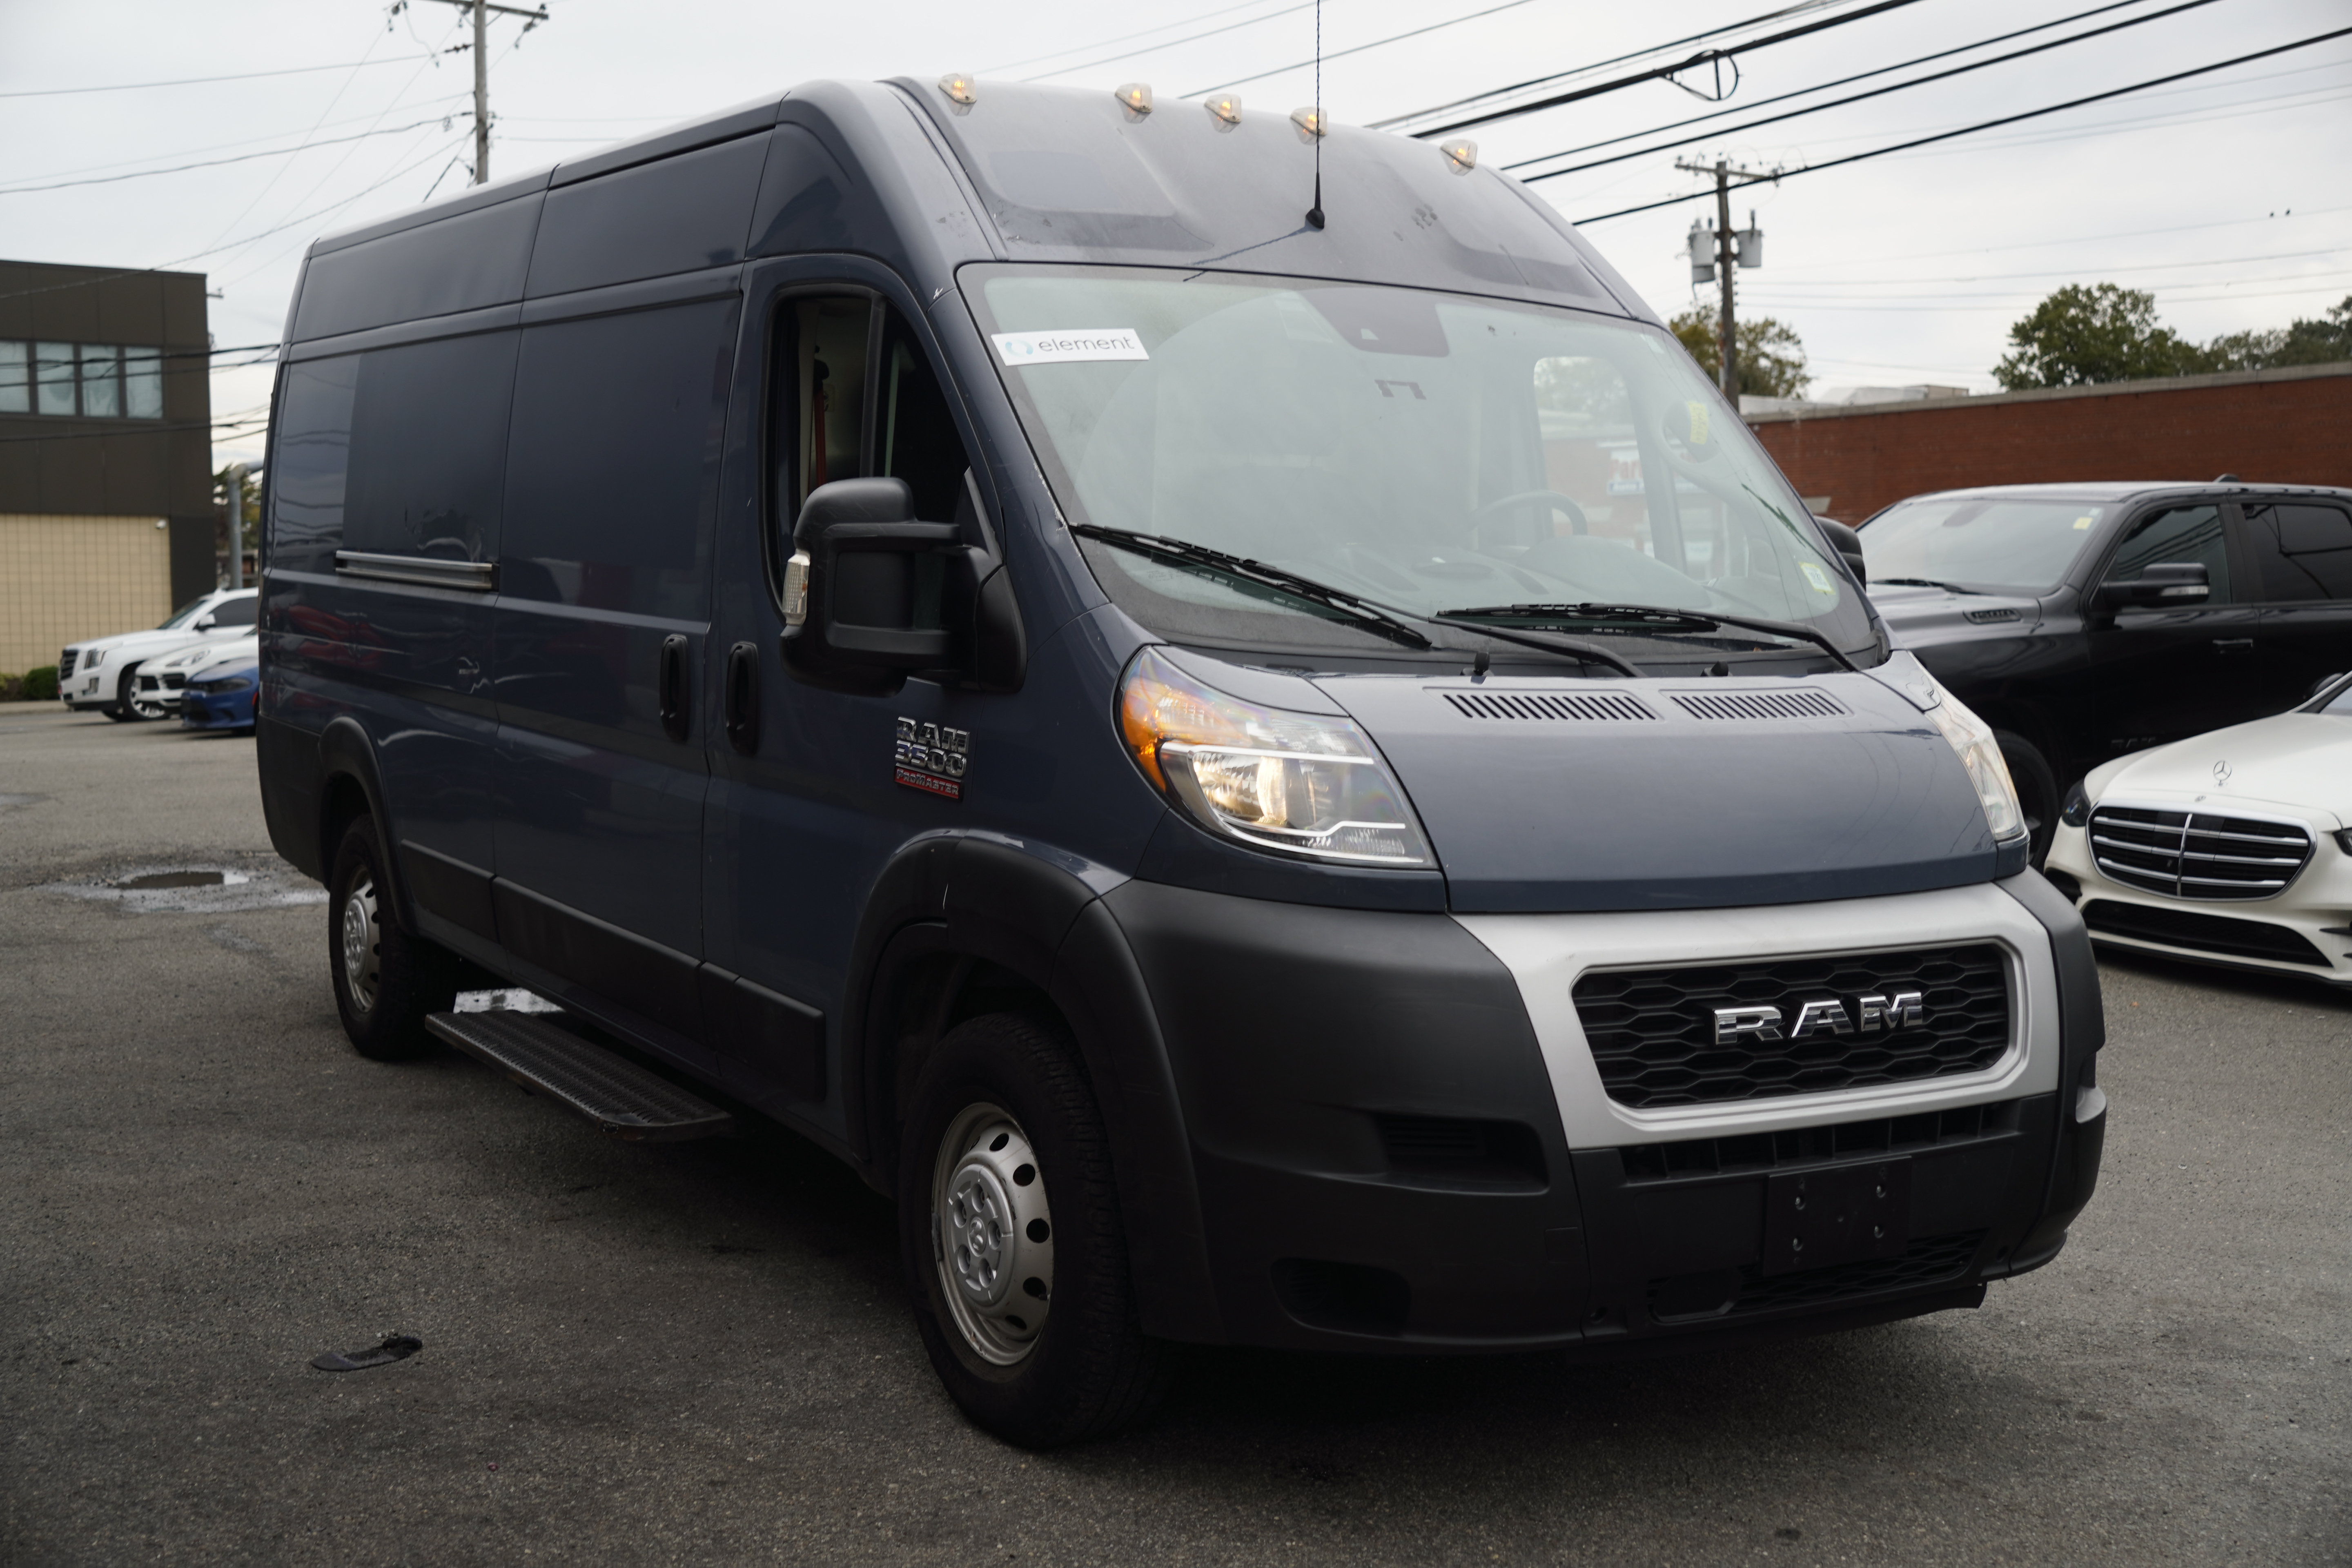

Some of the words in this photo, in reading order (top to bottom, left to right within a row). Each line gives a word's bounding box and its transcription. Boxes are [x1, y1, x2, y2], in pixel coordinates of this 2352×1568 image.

[1038, 336, 1135, 352] element
[896, 716, 970, 754] RAM
[895, 739, 967, 777] 3500
[1712, 991, 1922, 1045] RAM
